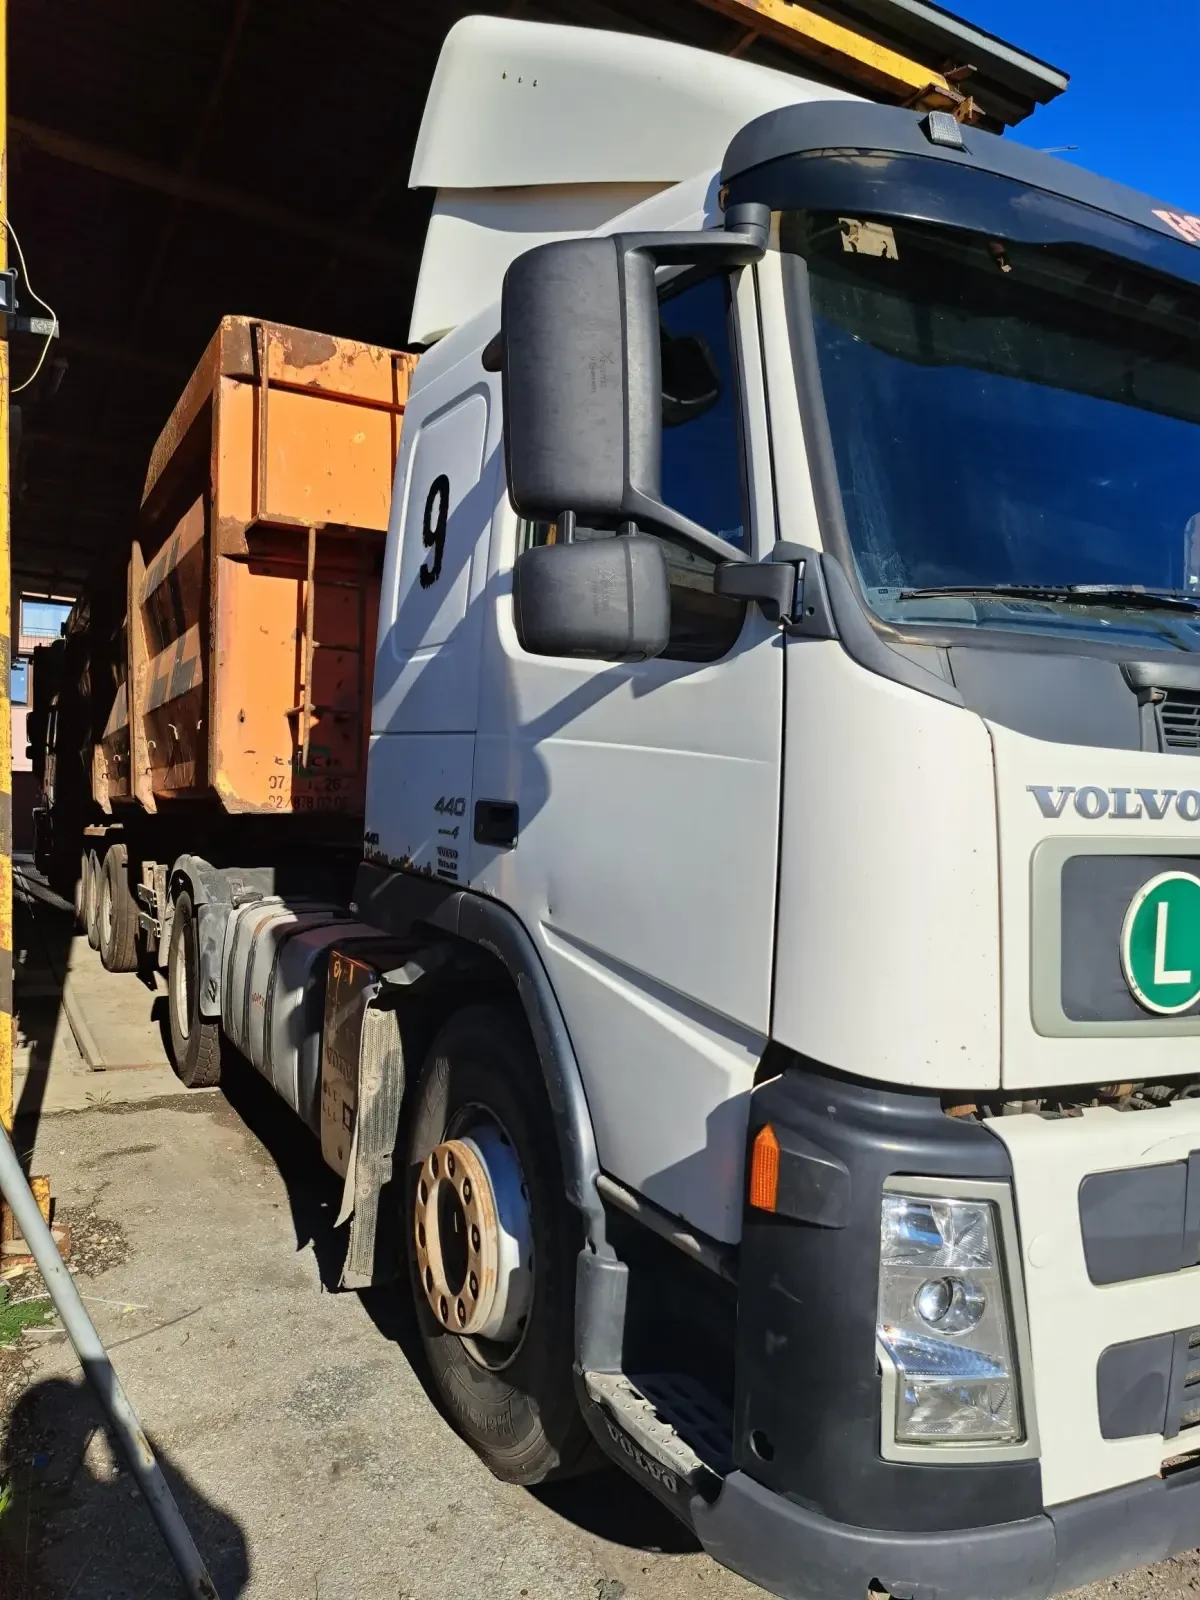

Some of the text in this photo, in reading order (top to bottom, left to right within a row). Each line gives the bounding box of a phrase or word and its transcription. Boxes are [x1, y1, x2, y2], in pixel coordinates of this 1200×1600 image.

[420, 473, 450, 590] 9
[434, 795, 466, 817] 440
[1026, 784, 1200, 822] VOLVO
[1153, 901, 1192, 985] L
[606, 1421, 678, 1494] VOLVO
